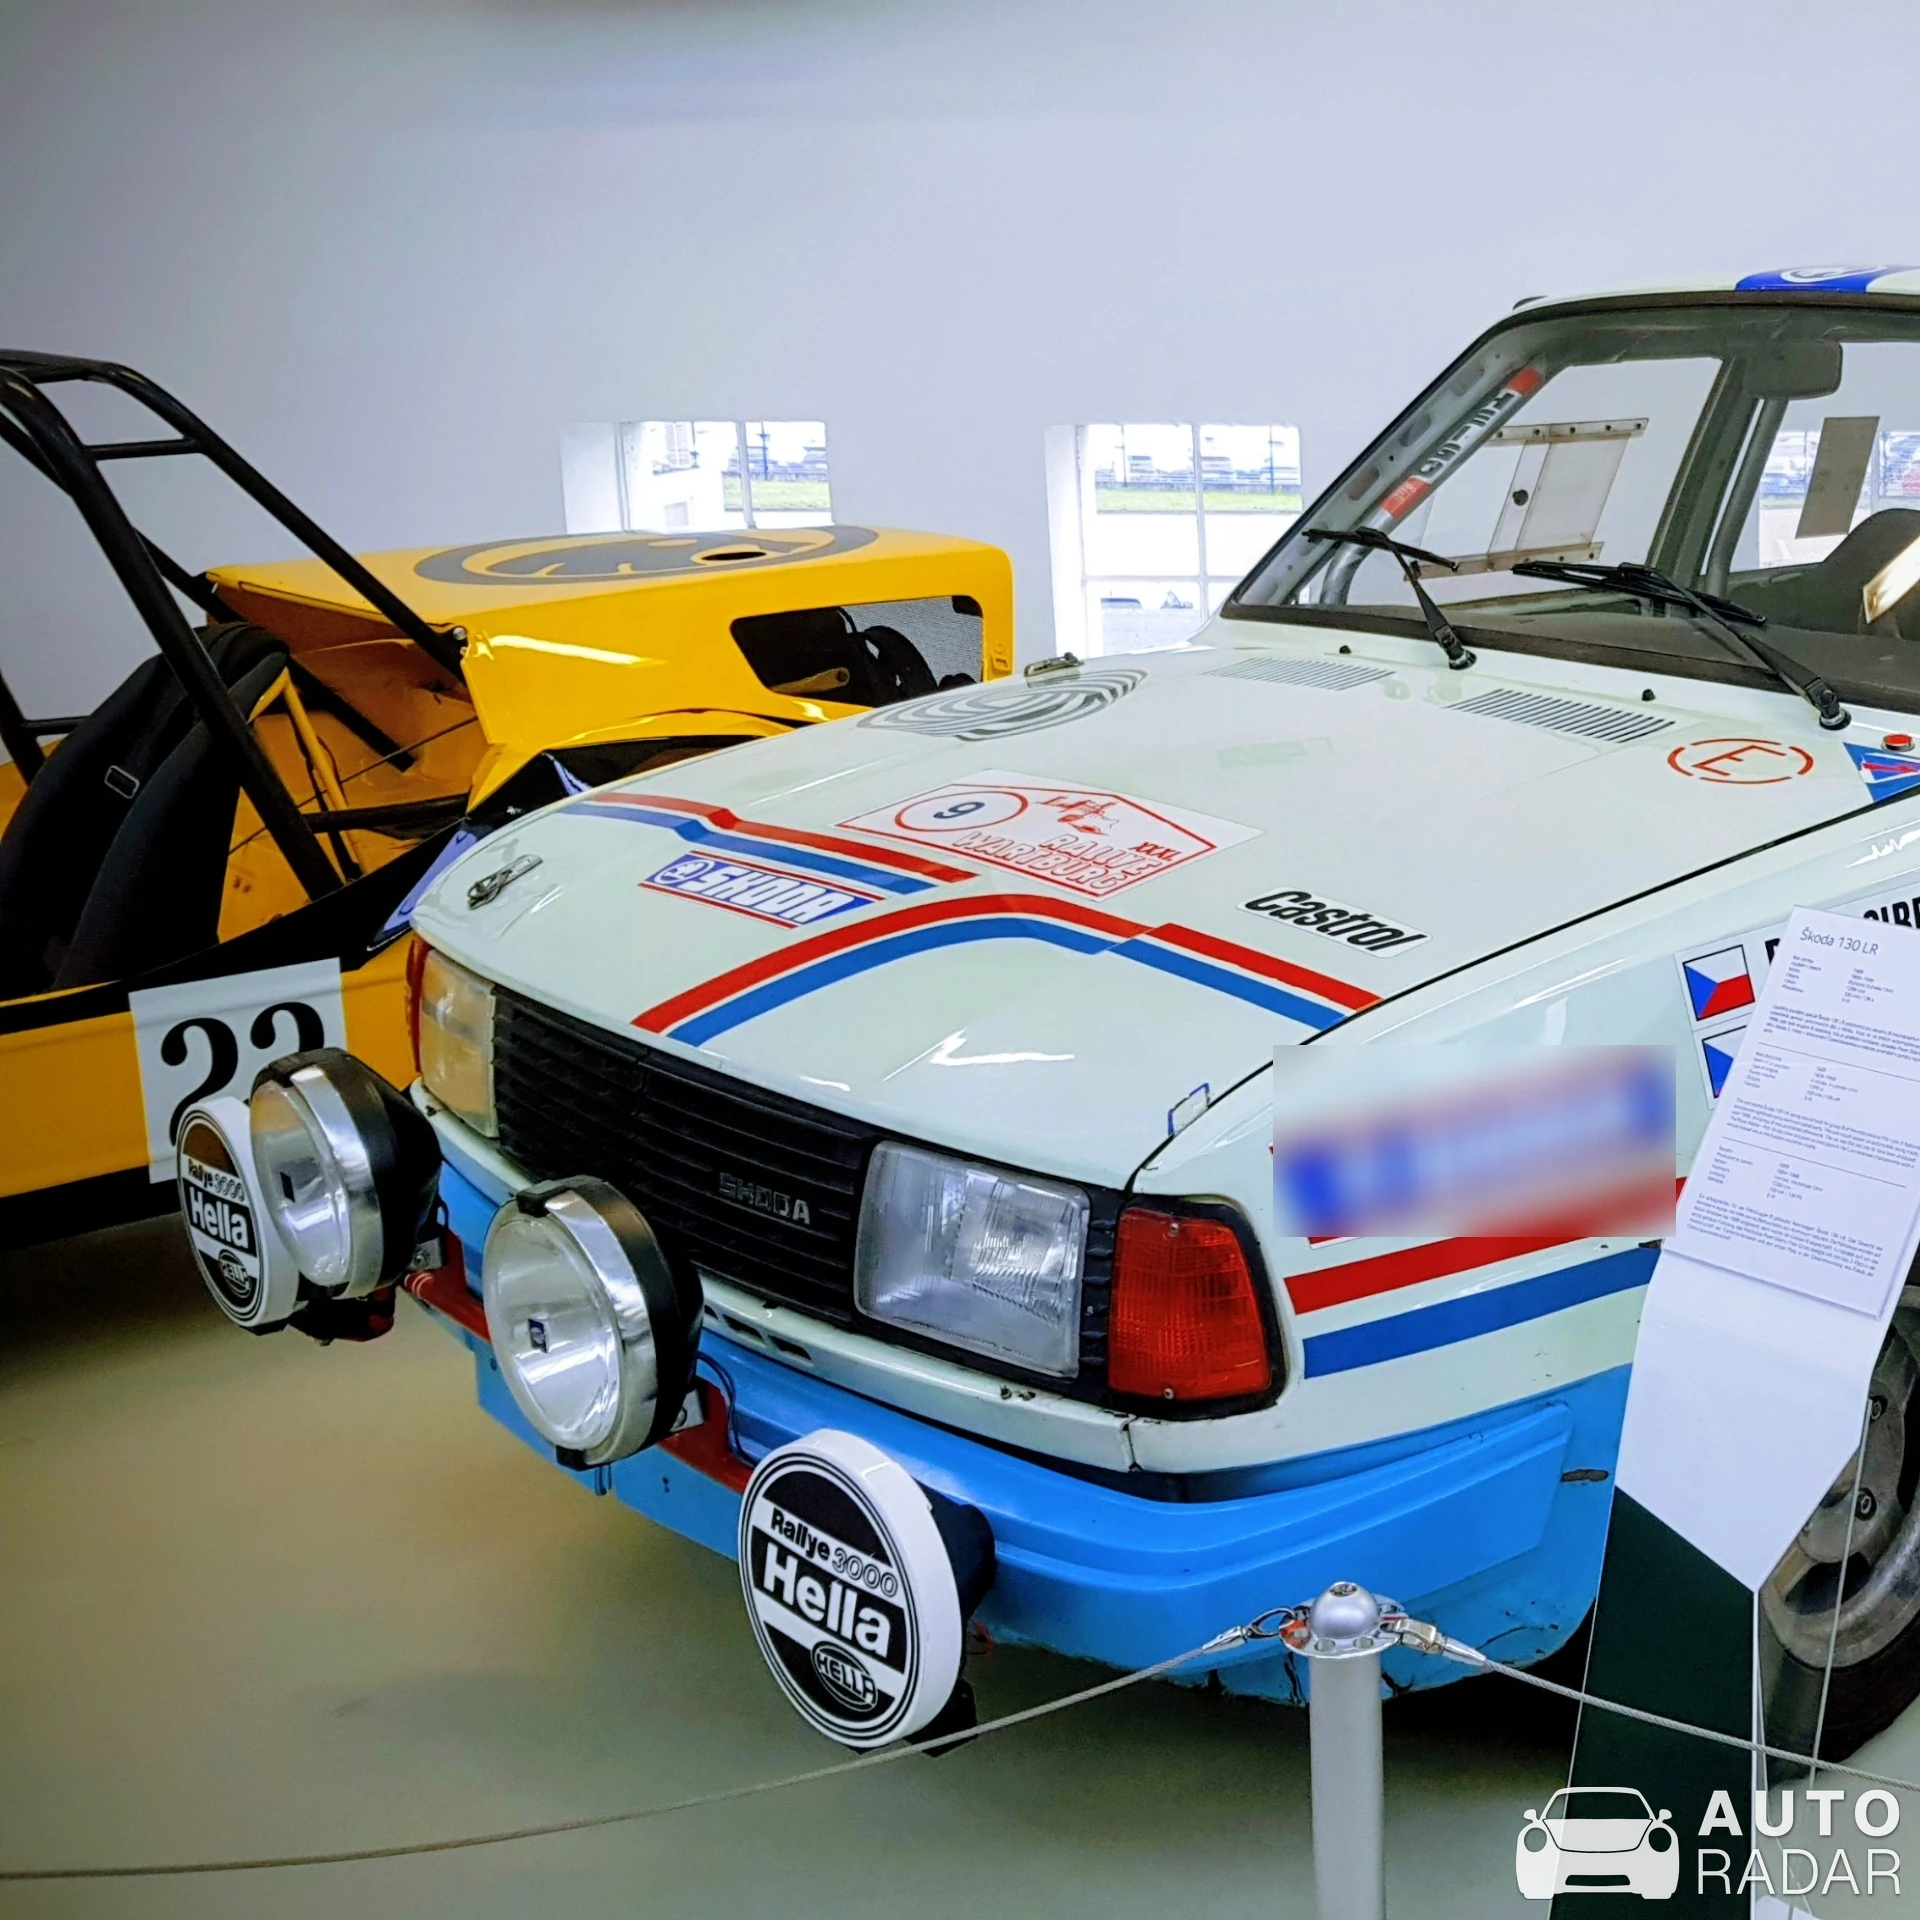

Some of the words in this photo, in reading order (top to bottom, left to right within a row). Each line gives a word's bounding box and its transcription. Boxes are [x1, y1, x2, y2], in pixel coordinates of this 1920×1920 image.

[933, 801, 986, 820] 9
[952, 830, 1124, 889] WARTBURG
[1039, 832, 1163, 875] RALLYE
[1245, 891, 1428, 951] Castrol
[1799, 926, 1834, 947] Škoda
[1838, 936, 1861, 952] 130
[1862, 940, 1879, 956] LR
[214, 1173, 244, 1202] 3000
[189, 1186, 249, 1250] Hella
[771, 1509, 830, 1561] Rallye
[832, 1547, 898, 1598] 3000
[763, 1541, 891, 1658] Hella
[815, 1648, 877, 1703] HELLA
